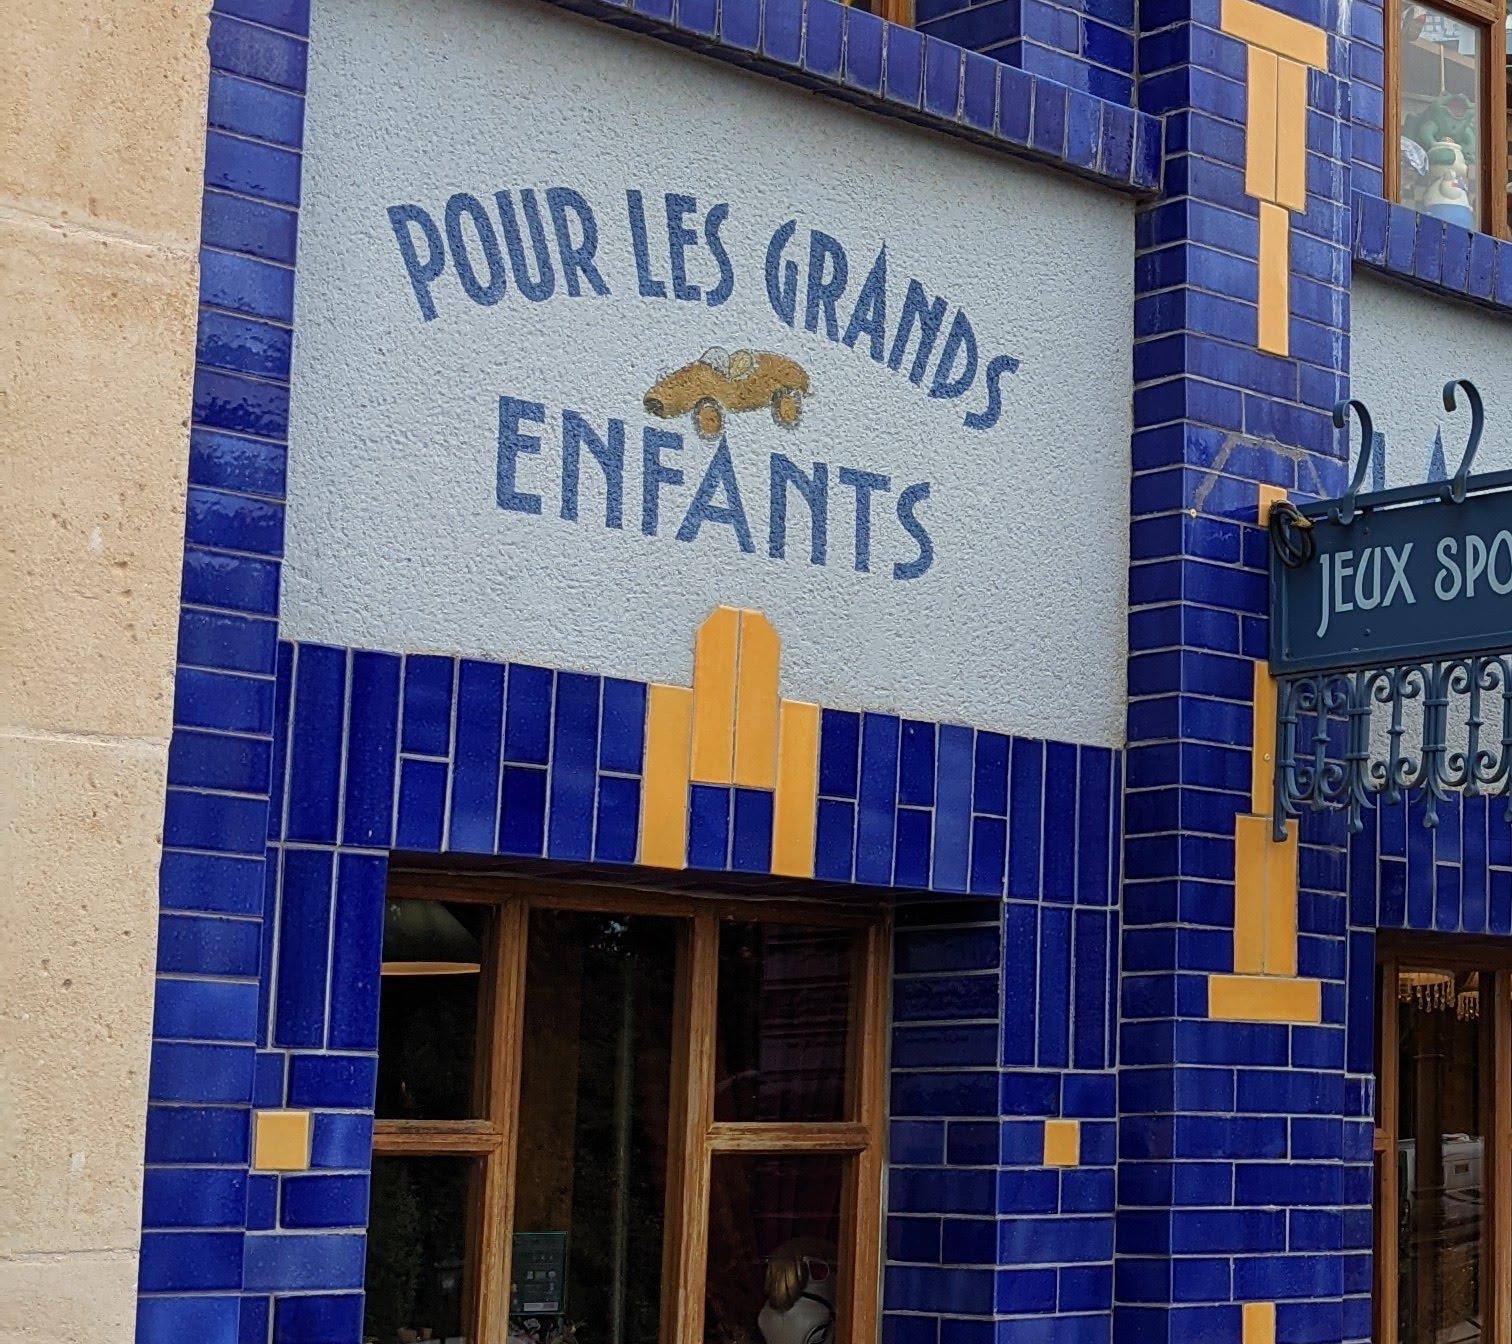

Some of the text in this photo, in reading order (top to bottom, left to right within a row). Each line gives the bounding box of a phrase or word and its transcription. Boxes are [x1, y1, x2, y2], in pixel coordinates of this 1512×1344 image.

[387, 185, 1019, 429] POUR LES GRANDS
[496, 396, 934, 579] ENFANTS
[1317, 543, 1416, 637] JEUX
